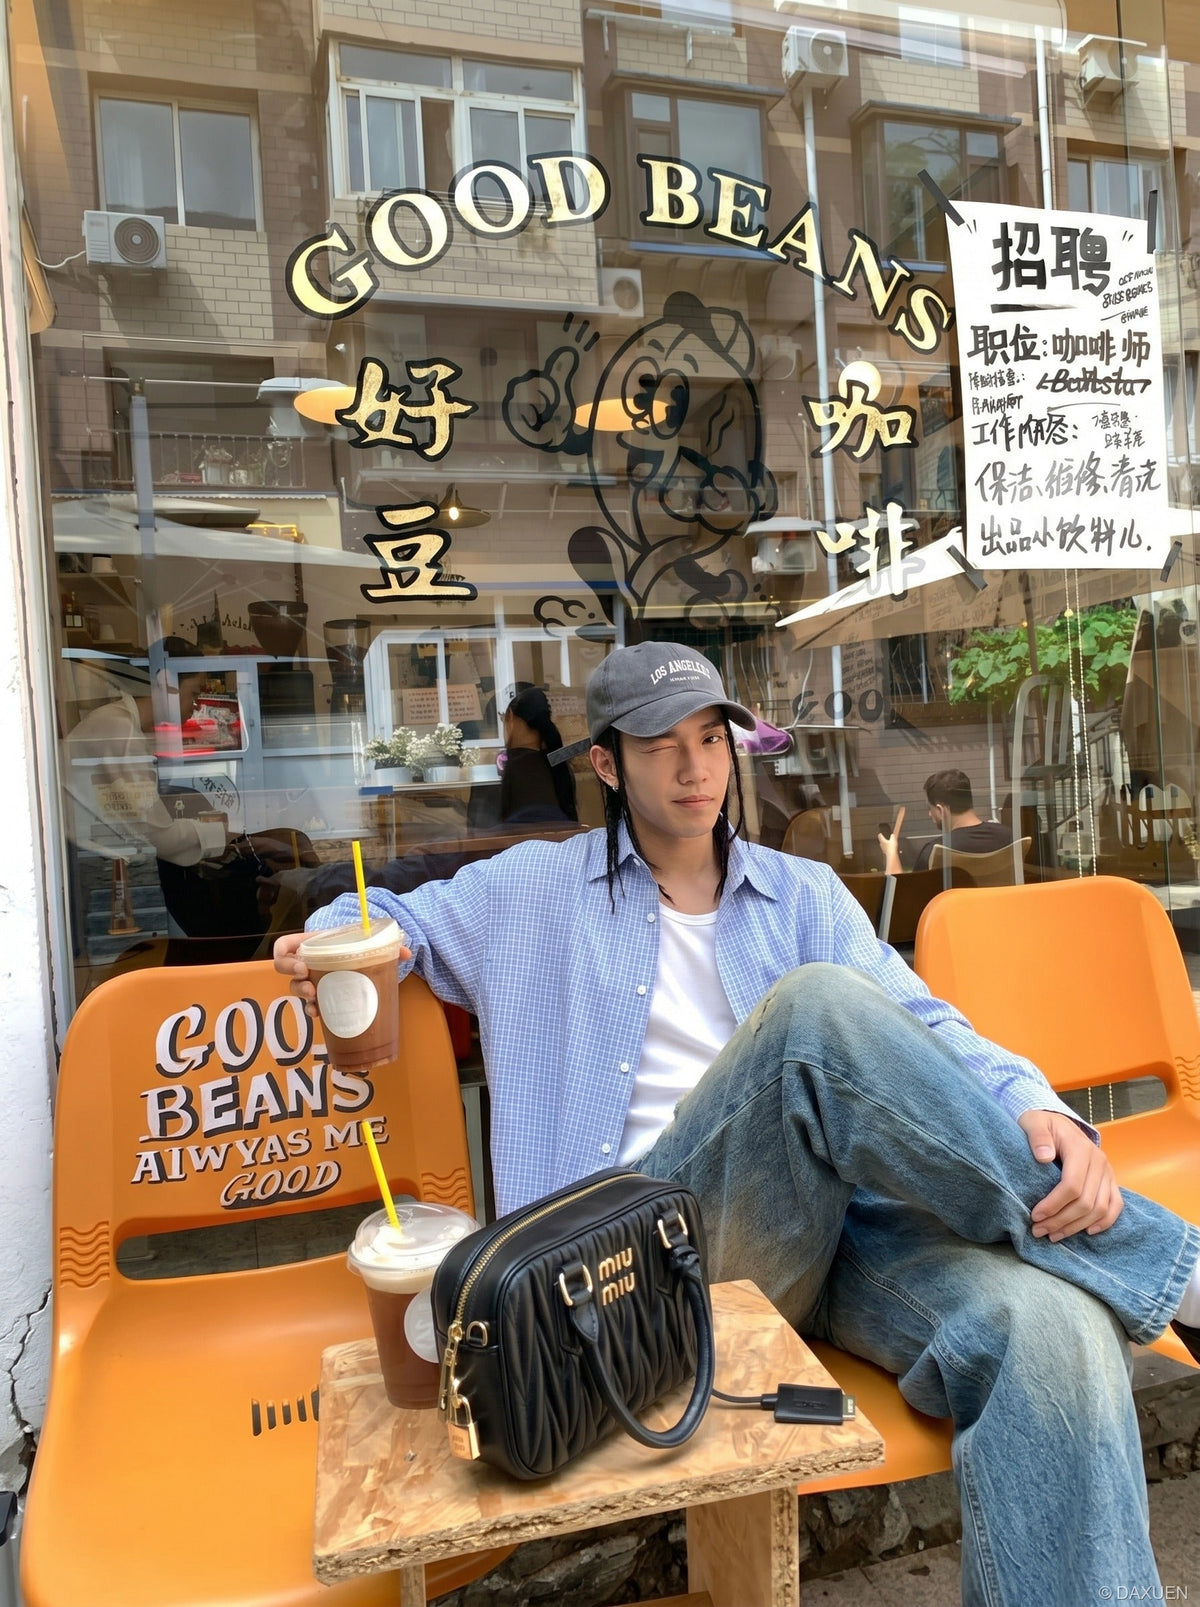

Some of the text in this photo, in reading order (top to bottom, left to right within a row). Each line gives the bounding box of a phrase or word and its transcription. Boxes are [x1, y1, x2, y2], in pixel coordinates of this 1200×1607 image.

[286, 151, 957, 354] GOOD BEANS
[991, 221, 1111, 297] 招聘
[650, 665, 668, 686] LOS
[155, 994, 331, 1079] GOO
[138, 1063, 375, 1143] BEANS
[322, 1115, 389, 1152] ME
[219, 1160, 342, 1210] GOOD
